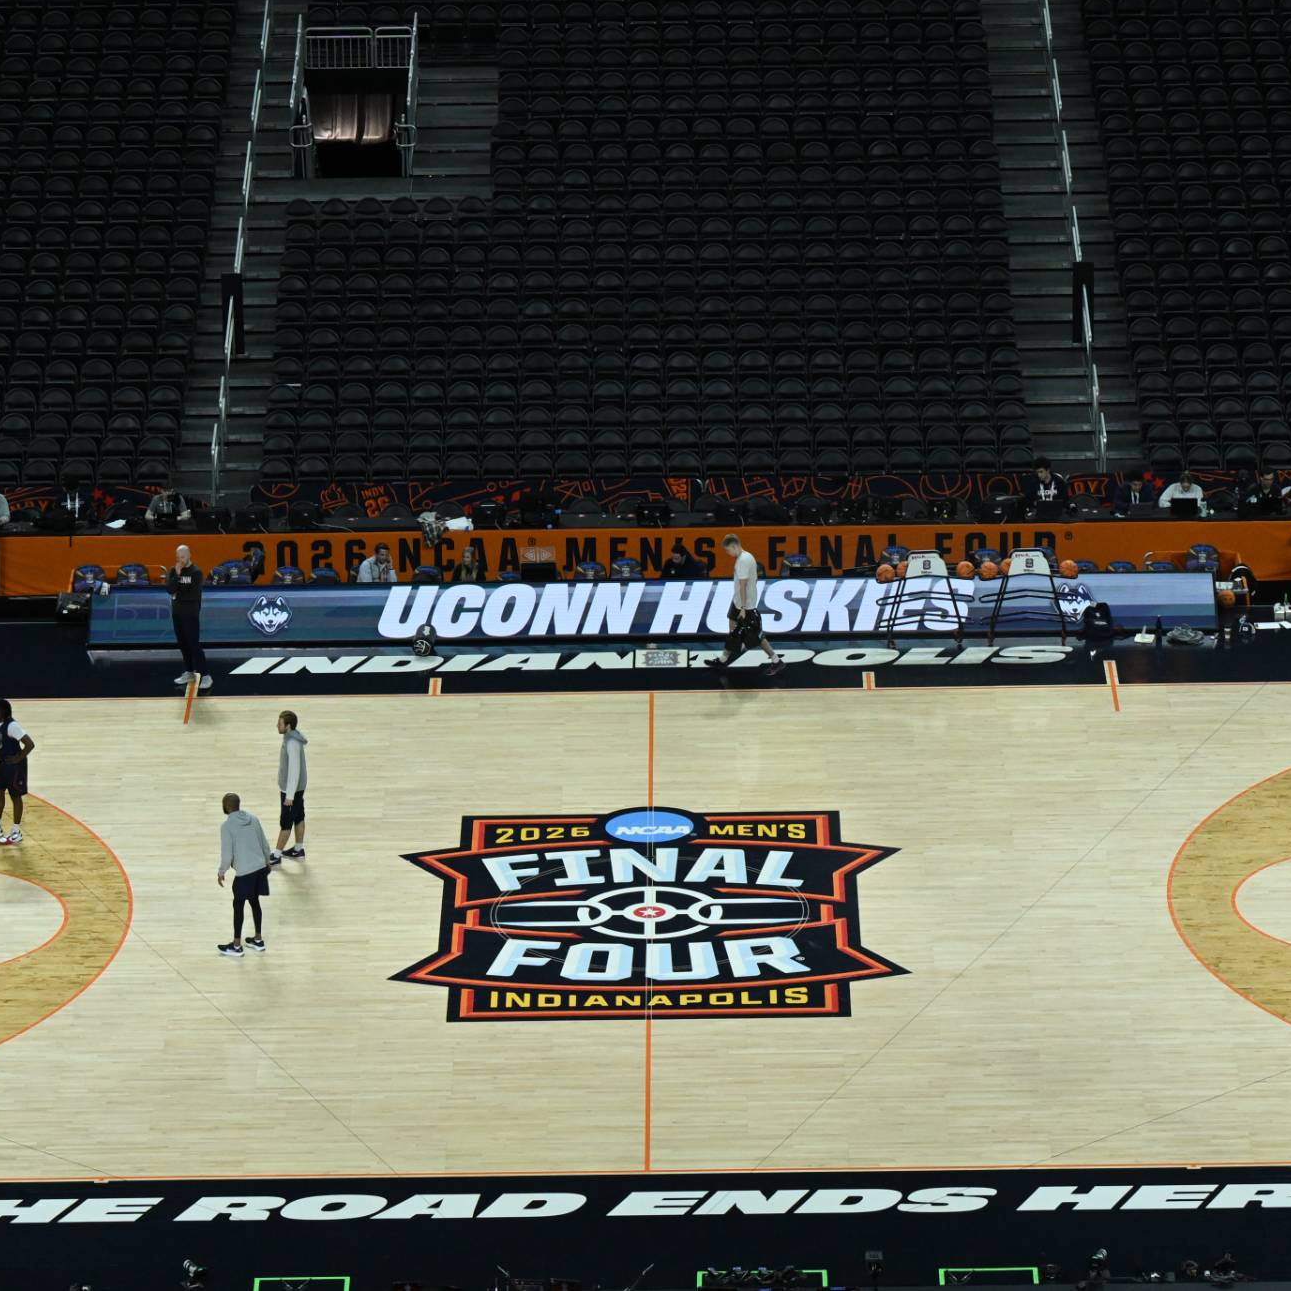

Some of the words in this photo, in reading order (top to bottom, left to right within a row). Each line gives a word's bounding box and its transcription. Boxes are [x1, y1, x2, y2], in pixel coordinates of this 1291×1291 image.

[377, 582, 645, 638] UCONN
[496, 825, 590, 844] 2026
[615, 823, 692, 837] NCAA
[709, 823, 807, 840] MEN'S
[481, 847, 805, 892] FINAL
[486, 937, 812, 982] FOUR
[490, 986, 809, 1009] INDIANAPOLIS
[173, 1191, 588, 1222] ROAD
[606, 1186, 998, 1218] ENDS
